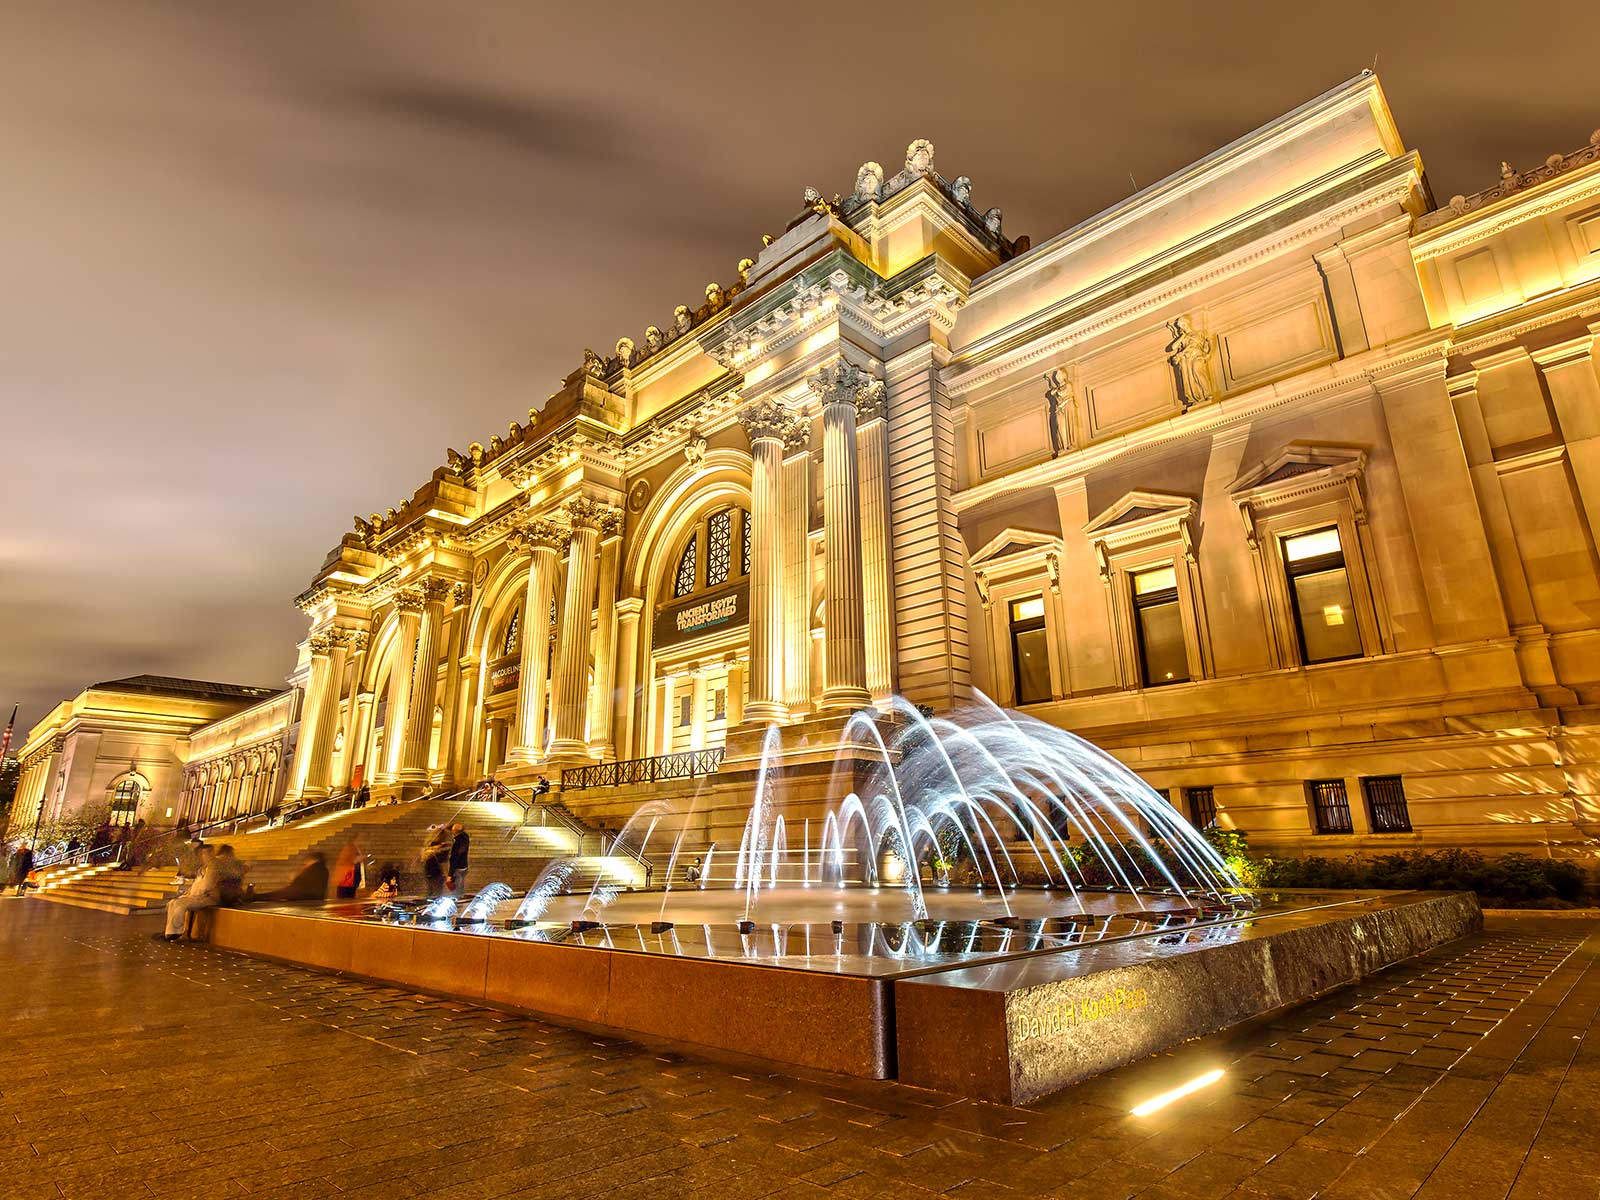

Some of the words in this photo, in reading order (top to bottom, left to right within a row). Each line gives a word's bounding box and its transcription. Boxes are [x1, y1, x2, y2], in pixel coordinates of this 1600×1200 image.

[677, 603, 709, 621] ANCIENT
[711, 594, 738, 611] EGYPT
[677, 605, 737, 630] TRANSFORMED
[1018, 1007, 1062, 1041] David
[1065, 1003, 1079, 1028] H.
[1081, 993, 1114, 1021] Koch
[1116, 988, 1147, 1012] Plaza
